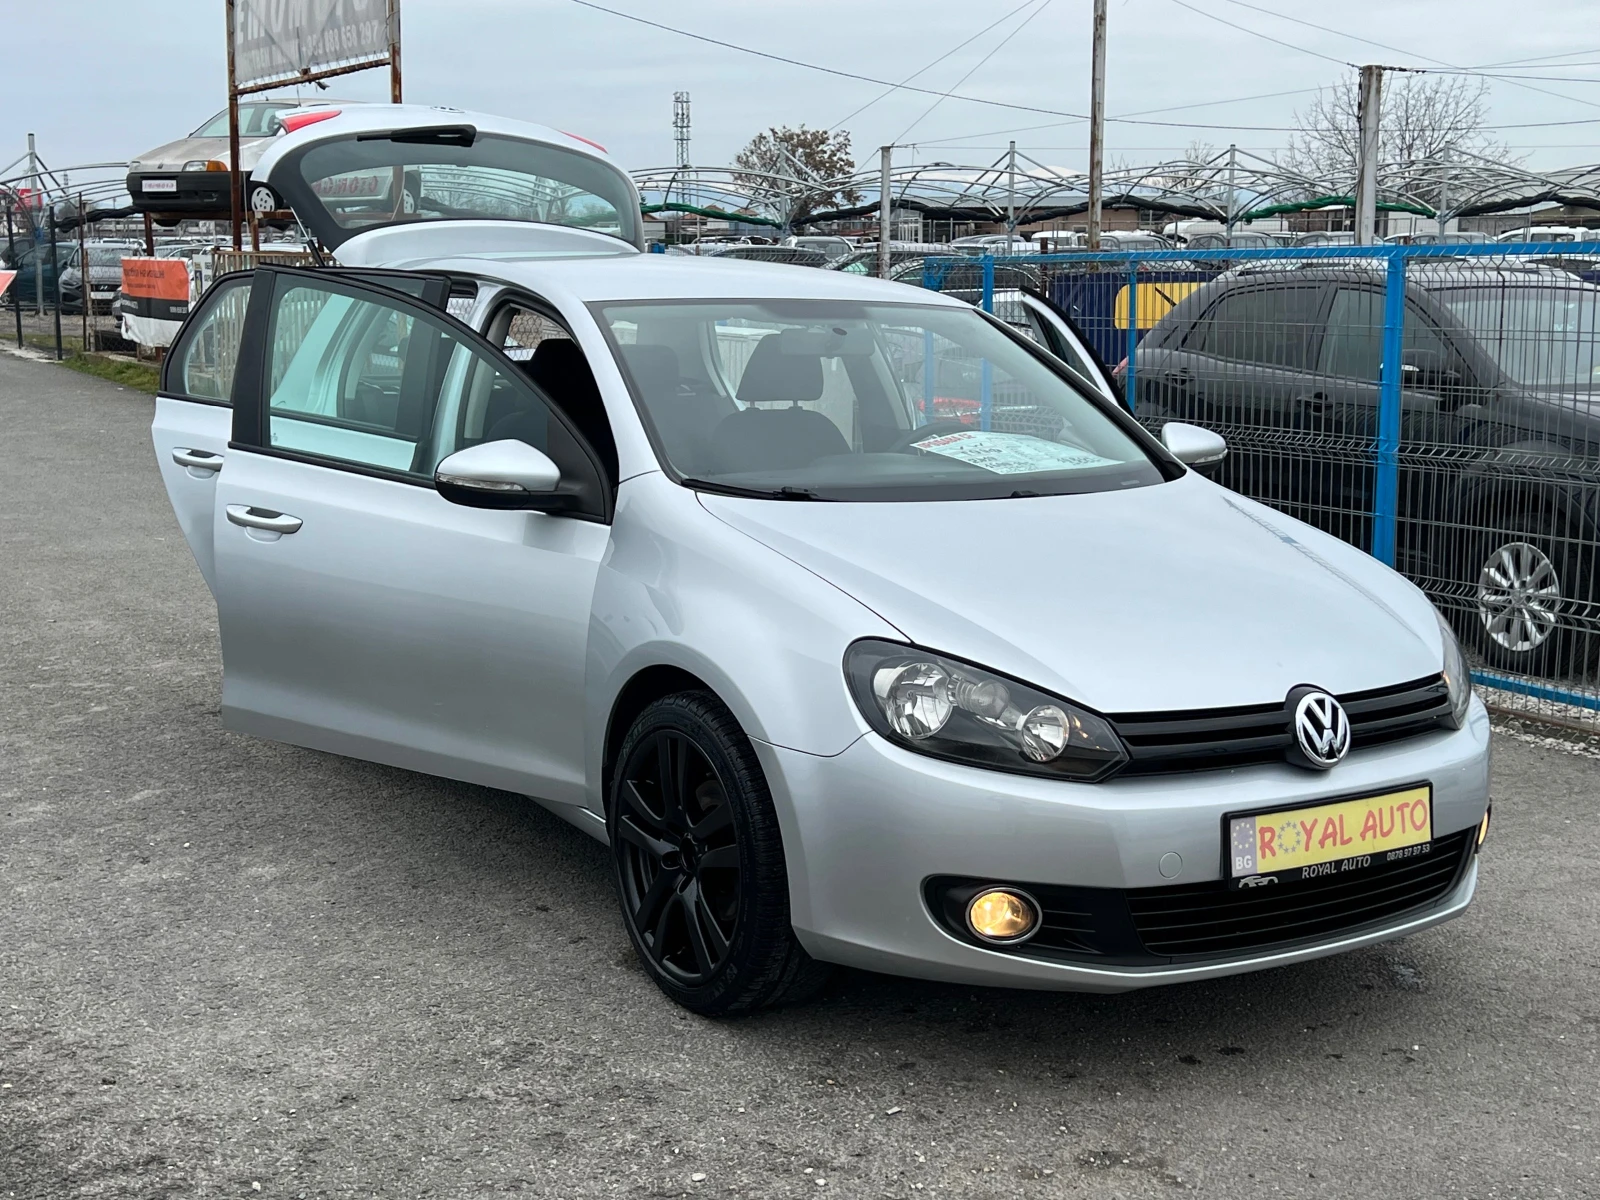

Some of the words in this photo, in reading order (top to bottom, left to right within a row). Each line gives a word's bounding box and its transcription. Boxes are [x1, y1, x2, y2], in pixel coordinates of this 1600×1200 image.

[359, 19, 379, 44] 297
[1258, 813, 1353, 860] ROYAL
[1360, 799, 1428, 841] AUTO
[1235, 855, 1253, 870] BG
[1301, 862, 1338, 879] ROYAL
[1341, 855, 1371, 871] AUTO
[1387, 849, 1403, 861] 0878
[1404, 847, 1413, 858] 97
[1413, 845, 1422, 856] 97
